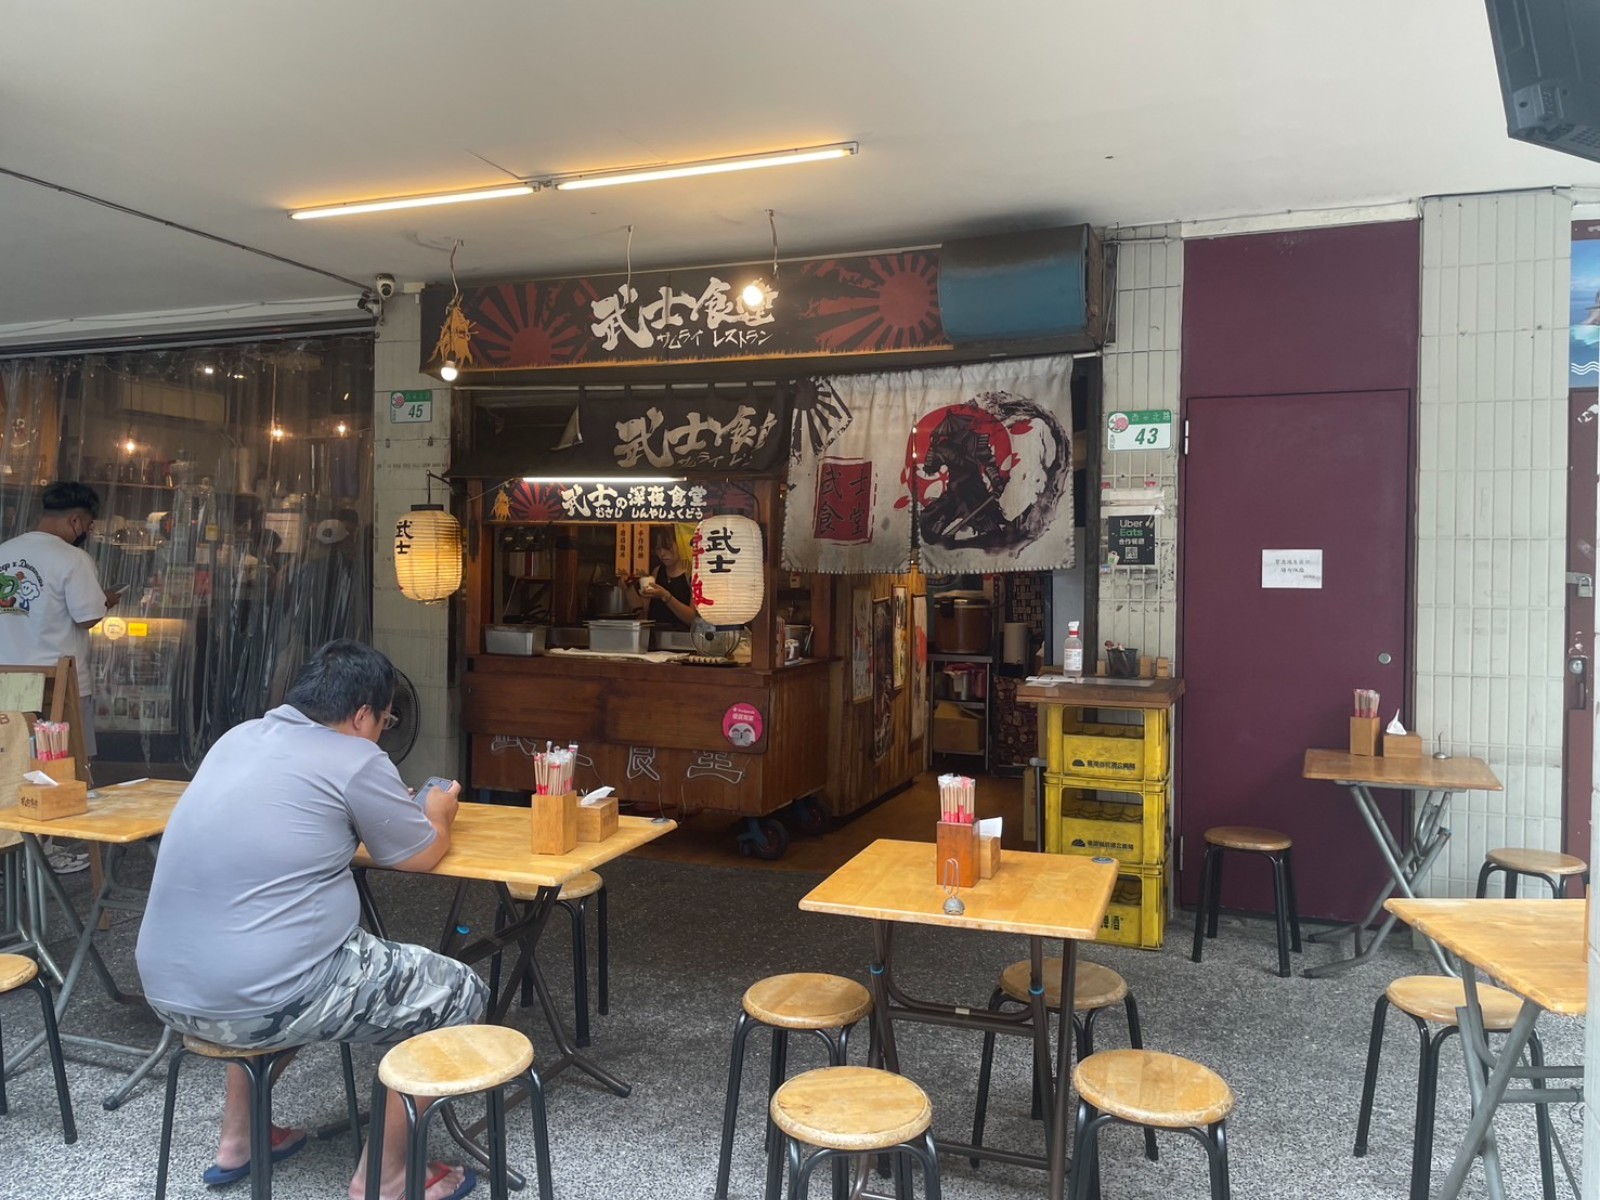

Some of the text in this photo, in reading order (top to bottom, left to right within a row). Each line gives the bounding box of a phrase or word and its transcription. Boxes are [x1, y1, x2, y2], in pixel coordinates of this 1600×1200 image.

[590, 277, 779, 351] 武士食堂
[656, 329, 774, 349] サムライ レストラン
[408, 404, 423, 418] 45
[1134, 428, 1159, 445] 43
[561, 484, 708, 517] 武士の深夜食堂
[1119, 519, 1143, 528] Uber
[1119, 528, 1143, 537] Eats
[395, 520, 414, 554] 武士
[705, 527, 741, 573] 武士
